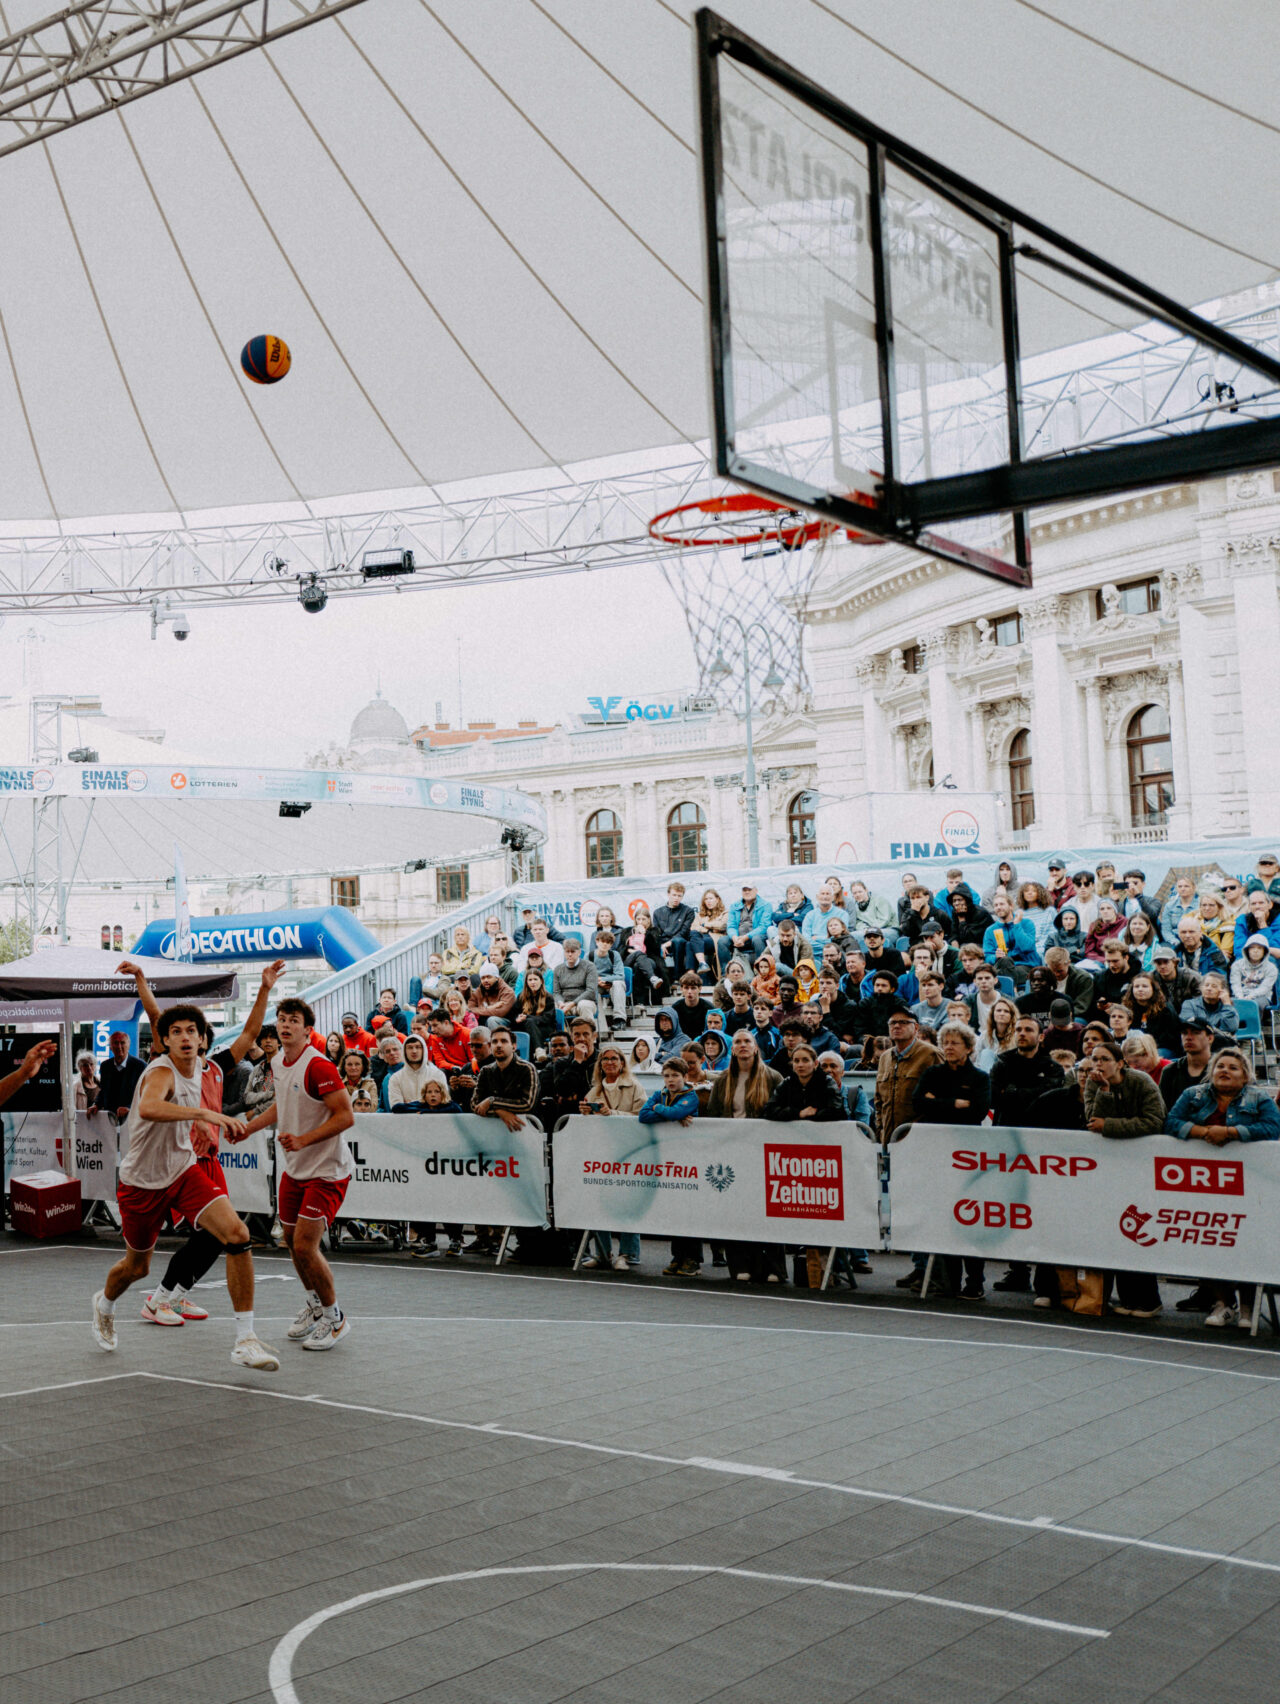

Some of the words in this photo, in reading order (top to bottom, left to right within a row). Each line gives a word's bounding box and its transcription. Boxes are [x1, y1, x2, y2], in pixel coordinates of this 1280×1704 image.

[625, 700, 674, 721] ÖGV
[82, 771, 129, 780] FINALS
[461, 787, 484, 799] FINALS
[945, 828, 976, 836] FINALS
[190, 925, 303, 954] DECATHLON
[75, 1138, 103, 1153] Stadt
[19, 1159, 34, 1167] Sport
[76, 1156, 103, 1170] Wien
[218, 1152, 258, 1169] ATHLON
[425, 1151, 519, 1179] druck.at
[583, 1160, 632, 1175] SPORT
[633, 1161, 698, 1179] AUSTRIA
[768, 1151, 838, 1178] Kronen
[951, 1150, 1097, 1177] SHARP
[355, 1168, 409, 1183] LEMANS
[583, 1177, 699, 1190] BUNDES-SPORTORGANISATION
[1161, 1164, 1237, 1188] ORF
[769, 1180, 839, 1210] Zeitung
[45, 1203, 76, 1219] win2day
[782, 1206, 827, 1214] UNABHÄNGIG
[953, 1198, 1033, 1230] ÖBB
[1156, 1208, 1247, 1229] SPORT
[1163, 1227, 1239, 1247] PASS
